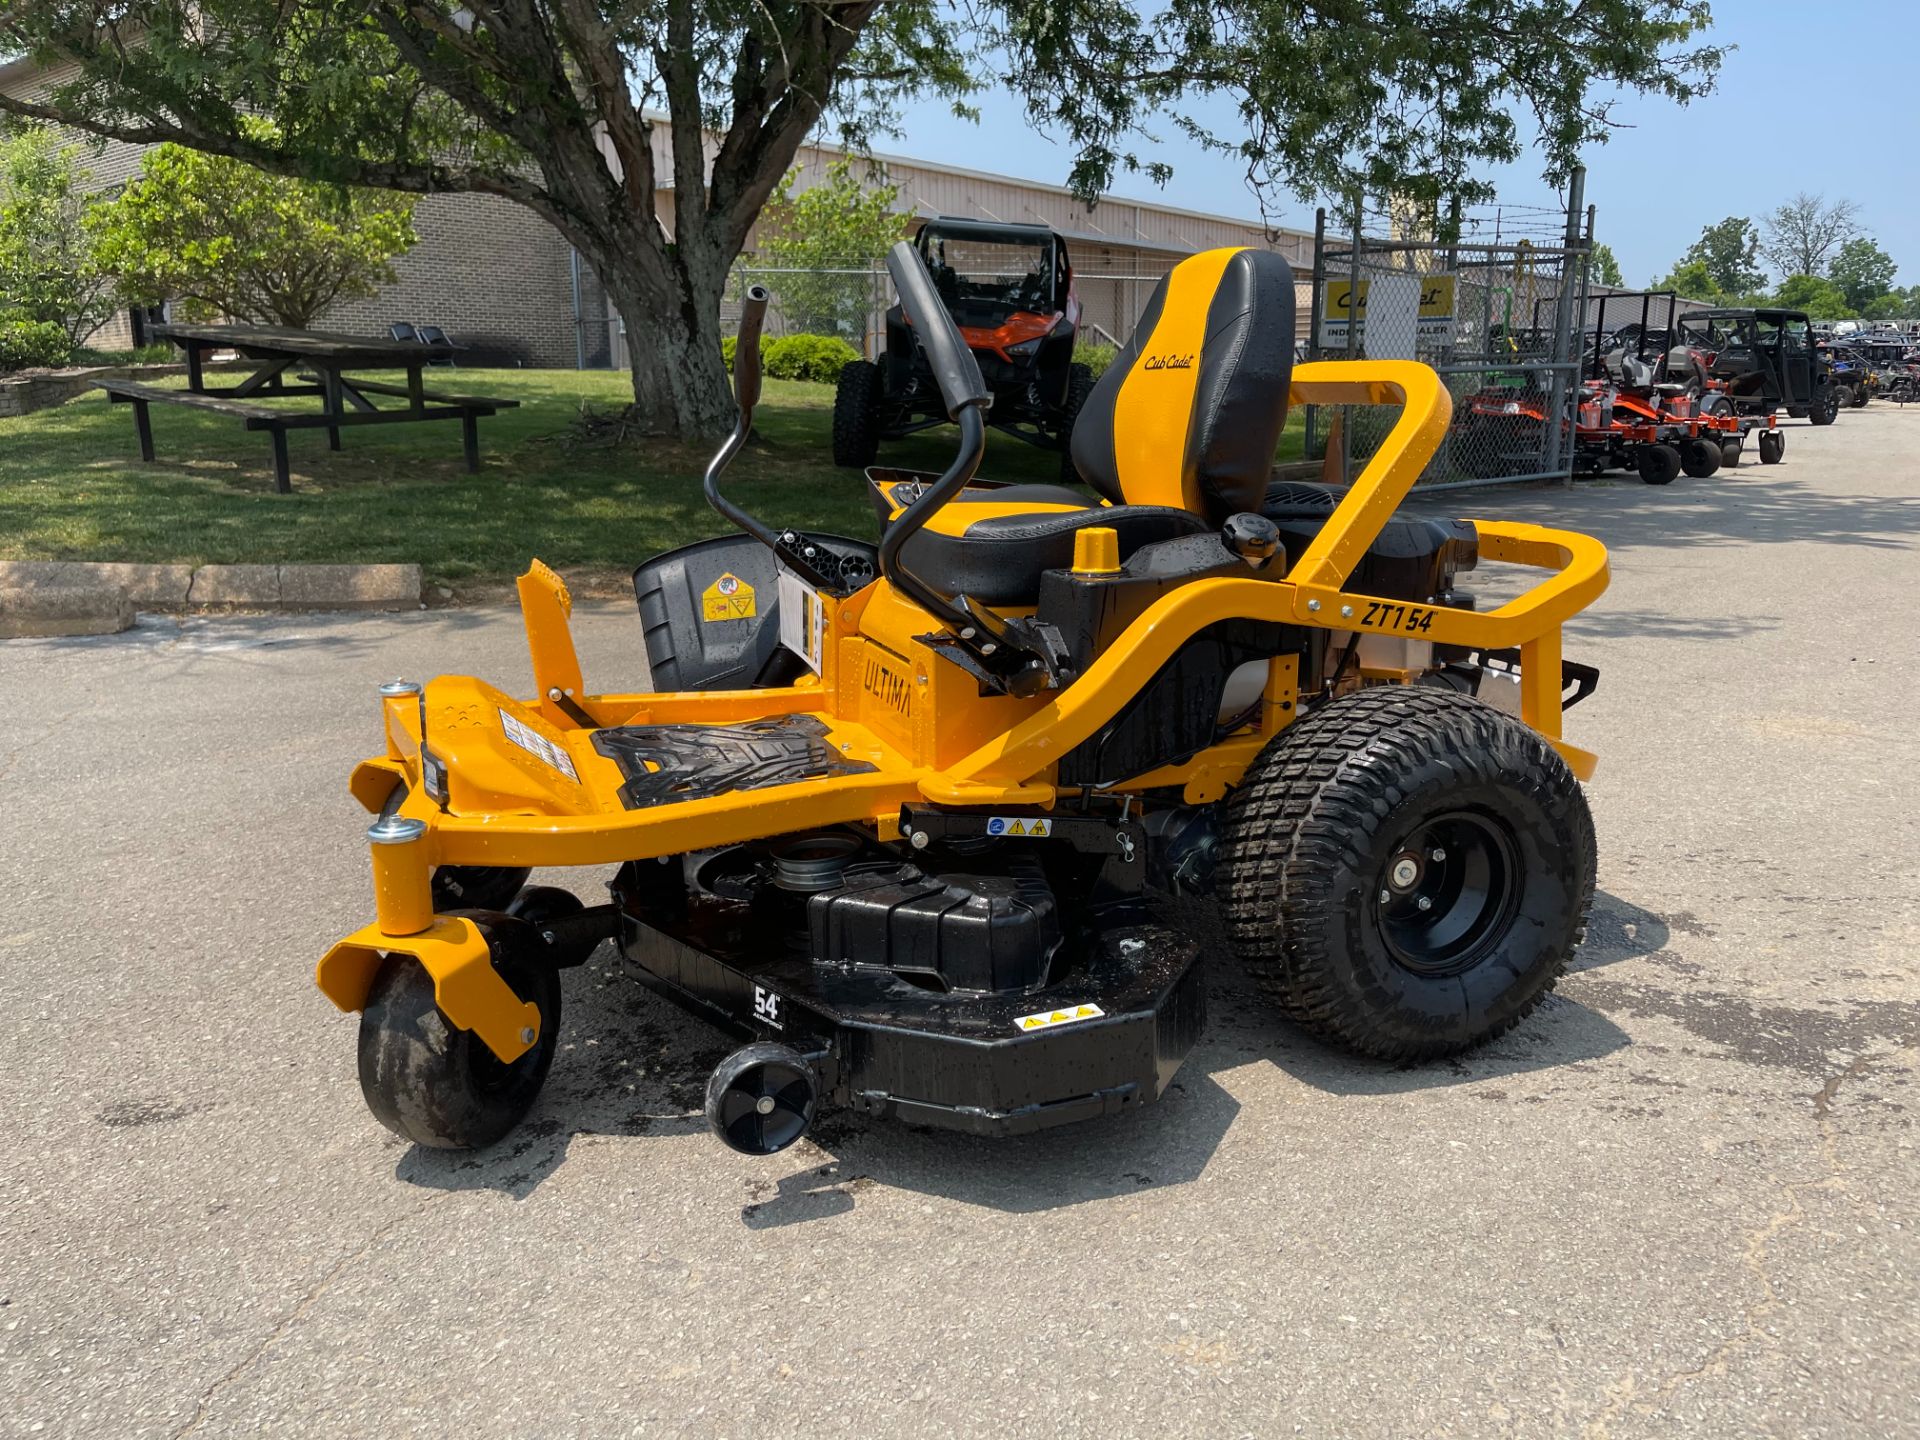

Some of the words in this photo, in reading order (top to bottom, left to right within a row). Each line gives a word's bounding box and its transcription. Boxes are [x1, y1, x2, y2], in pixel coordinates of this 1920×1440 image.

[1144, 355, 1166, 370] Cub
[1166, 353, 1194, 369] Cadet
[1361, 602, 1406, 629] ZT1
[864, 657, 911, 718] ULTIMA
